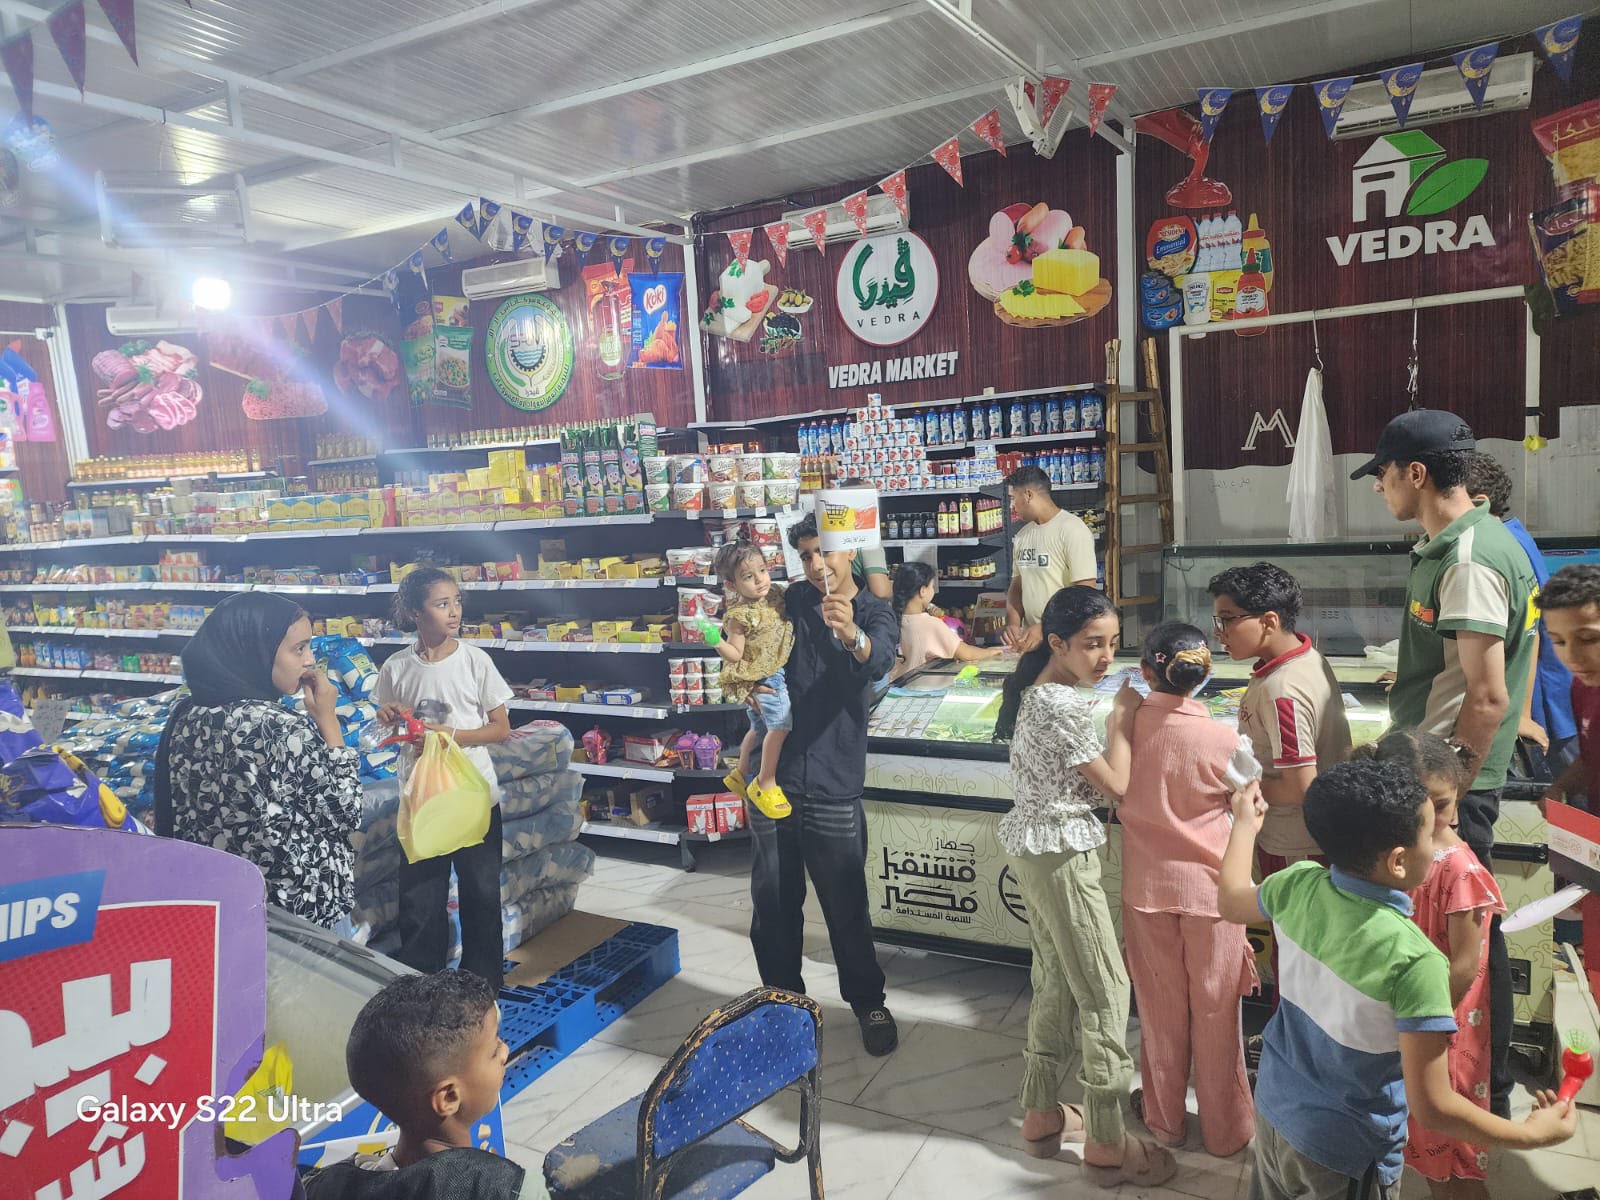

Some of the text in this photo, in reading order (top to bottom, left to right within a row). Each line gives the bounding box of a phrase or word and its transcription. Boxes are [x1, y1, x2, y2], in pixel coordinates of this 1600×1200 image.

[1326, 214, 1496, 267] VEDRA
[857, 311, 921, 329] VEDRA
[829, 351, 959, 389] VEDRA MARKET
[934, 837, 975, 857] جهاز
[896, 907, 972, 924] للتنمية المستدامة
